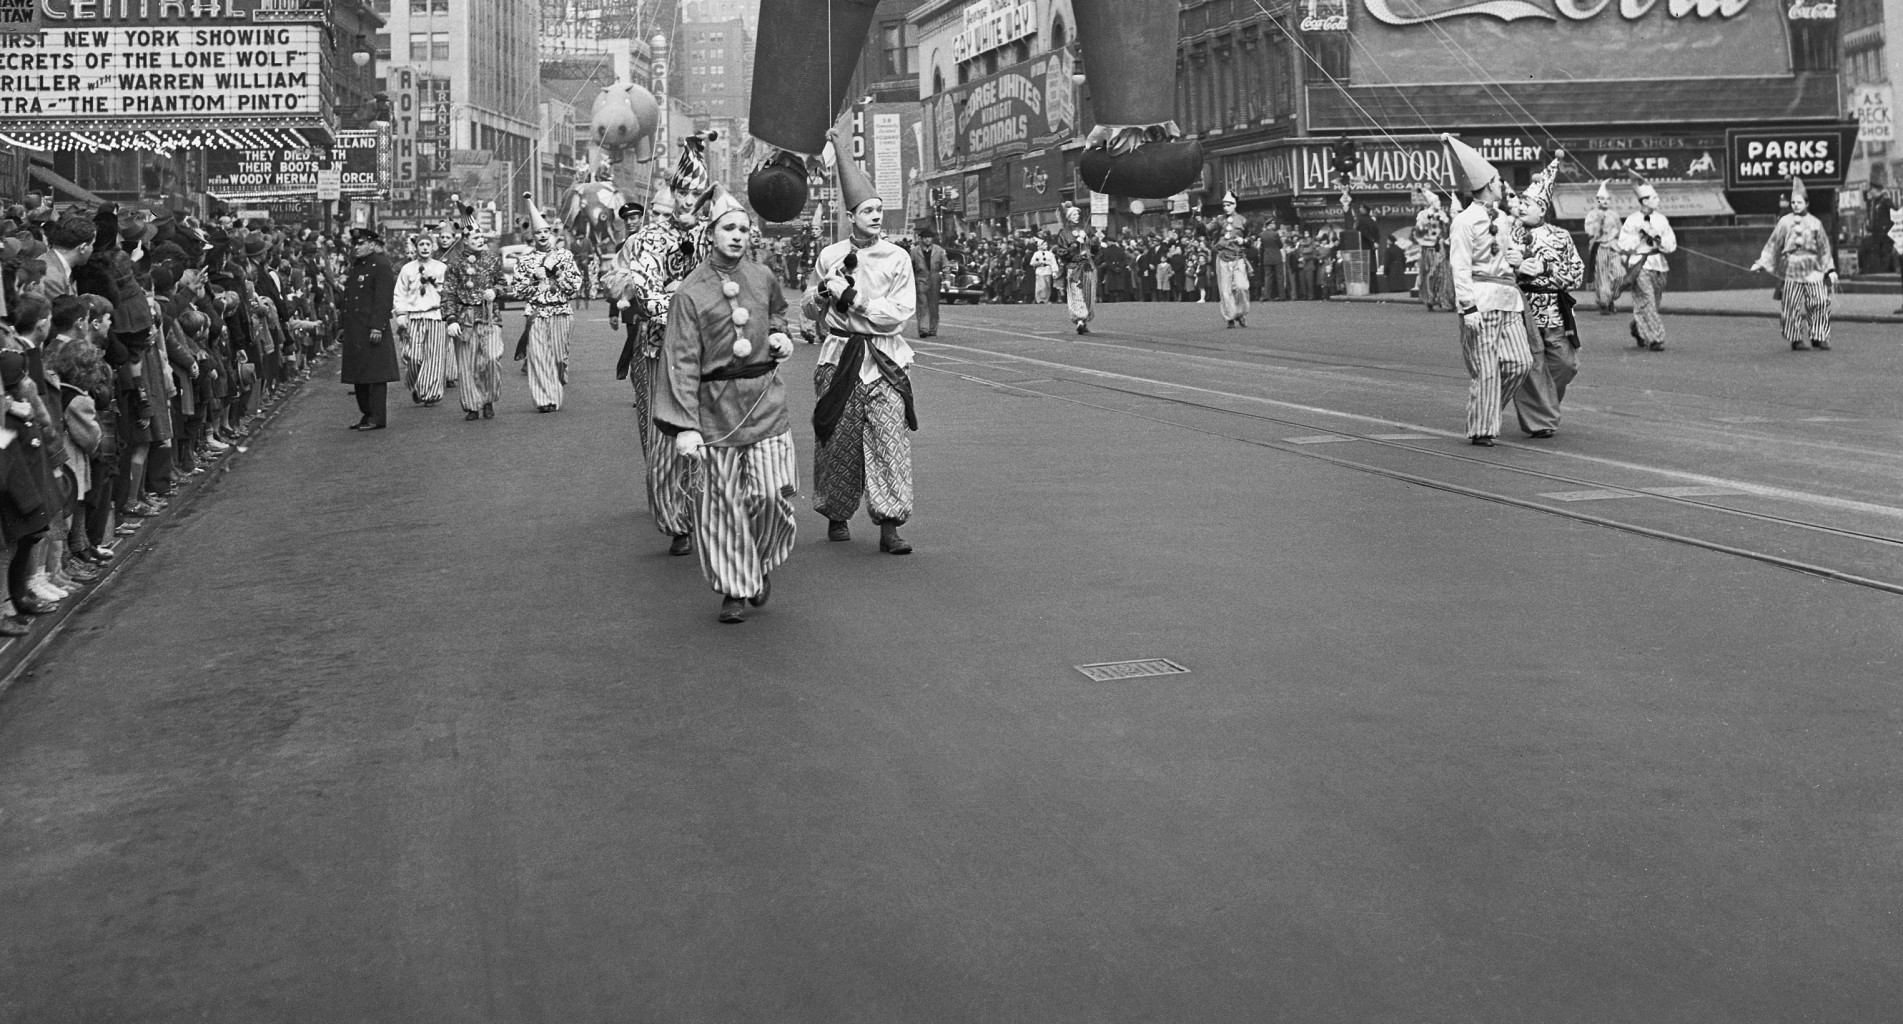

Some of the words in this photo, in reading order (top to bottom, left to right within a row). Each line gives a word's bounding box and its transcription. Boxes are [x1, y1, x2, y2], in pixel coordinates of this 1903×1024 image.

[0, 31, 49, 48] IRST
[64, 31, 109, 48] NEW
[124, 30, 180, 47] YORK
[195, 29, 290, 46] SHOWING
[953, 29, 972, 63] GAY
[85, 52, 113, 69] OF
[122, 52, 162, 69] THE
[171, 51, 226, 68] LONE
[118, 74, 205, 90] WARREN
[215, 72, 307, 89] WILLIAM
[122, 94, 226, 112] PHANTOM
[958, 80, 997, 136] GEORGE
[1857, 107, 1892, 124] BECK
[969, 114, 1028, 153] SCANDALS
[1861, 126, 1891, 137] SHOE
[333, 137, 377, 149] LLAND
[1483, 138, 1523, 146] RHEA
[1589, 139, 1634, 149] BRENT
[1639, 138, 1686, 148] SHOPS
[1748, 140, 1829, 159] PARKS
[238, 162, 273, 173] THEIR
[280, 161, 319, 172] BOOTS
[1597, 154, 1670, 171] KAYSER
[1740, 161, 1775, 176] HAT
[1777, 159, 1835, 176] SHOPS
[229, 174, 273, 185] WOODY
[275, 173, 317, 184] HERMA
[1383, 181, 1432, 191] CIGARS
